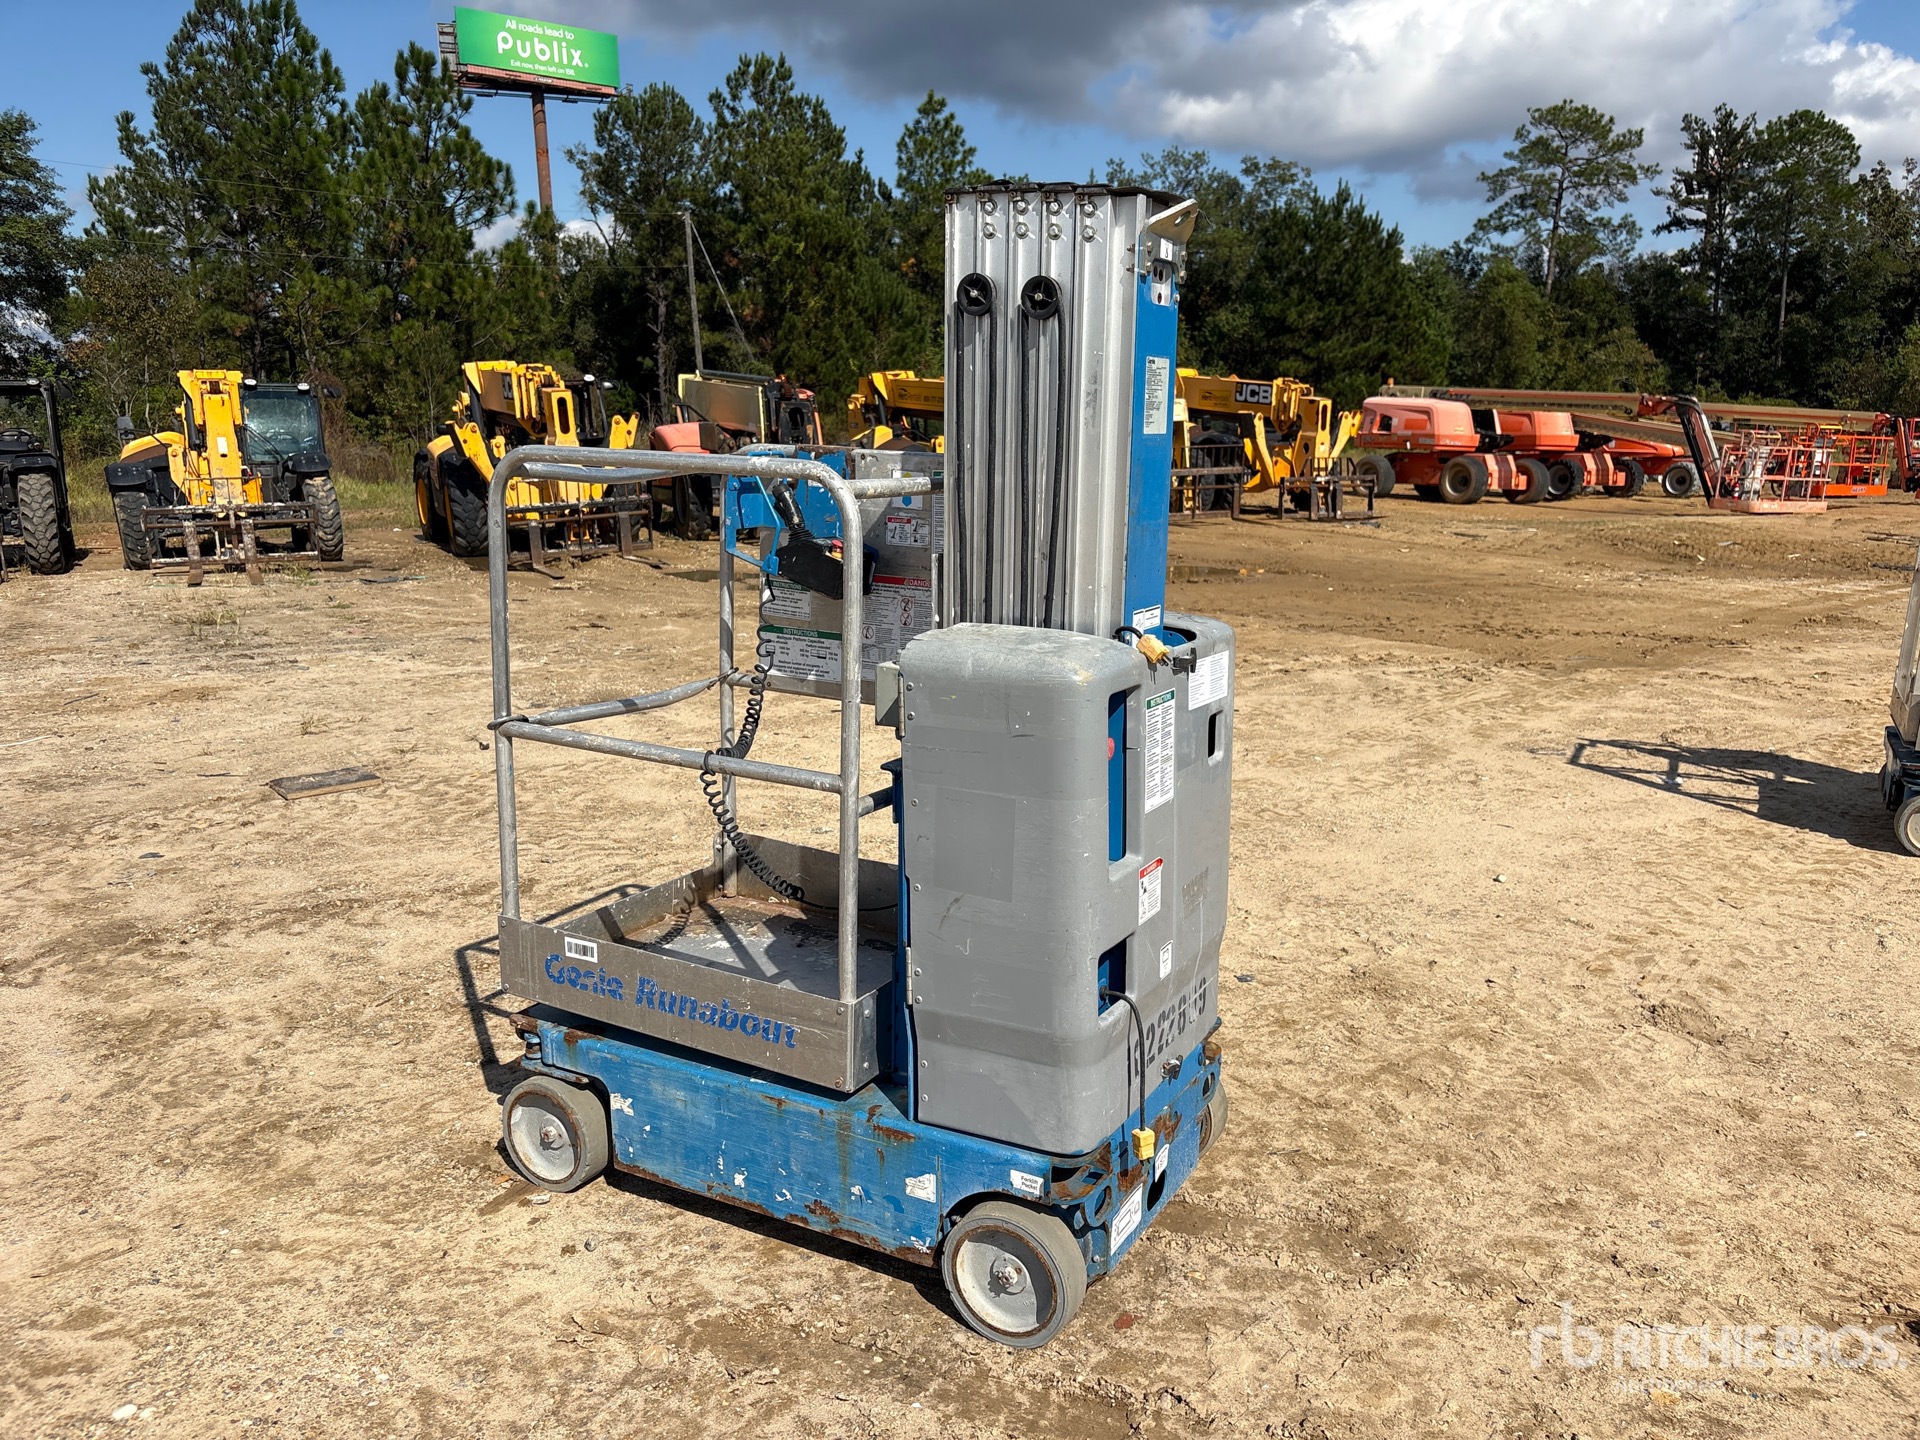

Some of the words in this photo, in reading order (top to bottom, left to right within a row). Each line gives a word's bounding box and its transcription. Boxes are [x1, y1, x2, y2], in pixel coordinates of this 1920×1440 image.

[506, 18, 516, 30] All
[518, 24, 543, 34] roads
[544, 26, 564, 38] lead
[564, 31, 574, 40] to
[510, 59, 521, 67] Exit
[1236, 384, 1272, 404] JCB
[783, 628, 818, 637] INSTRUCTIONS
[635, 975, 800, 1049] Runabout
[1021, 1175, 1038, 1185] Forklift
[1022, 1182, 1038, 1191] Pocket
